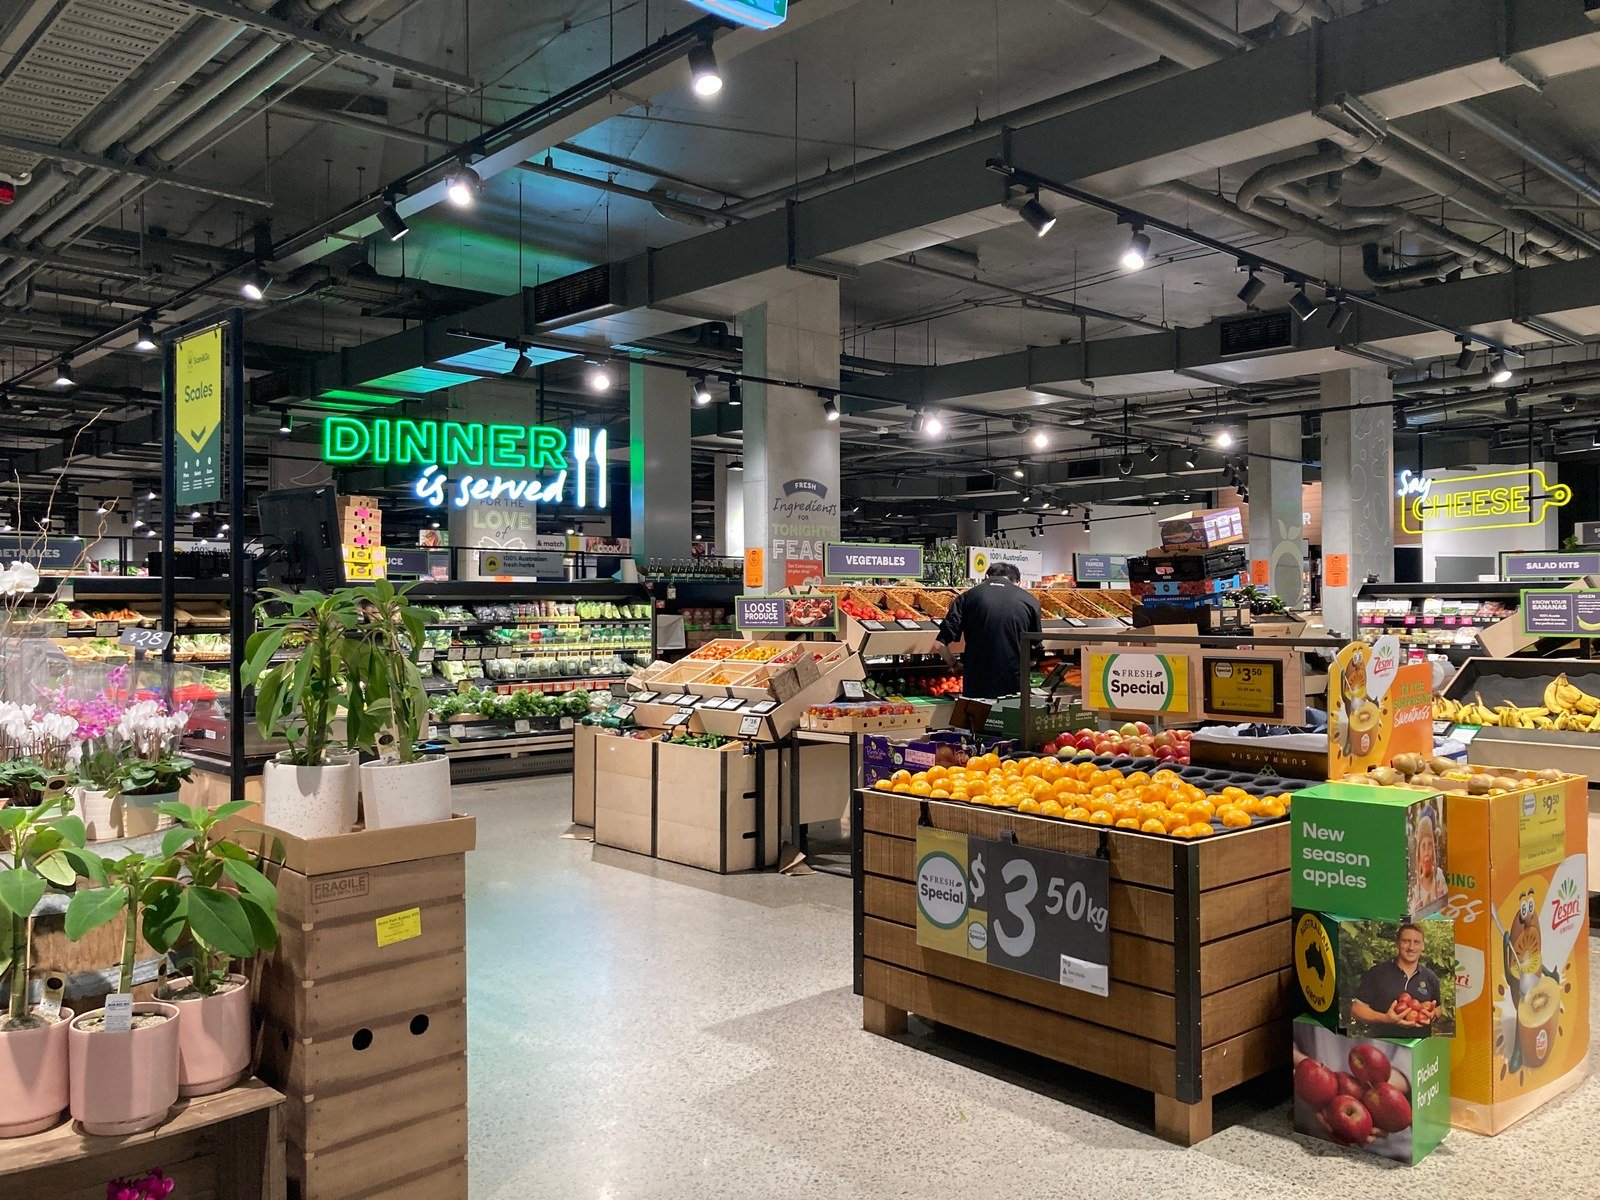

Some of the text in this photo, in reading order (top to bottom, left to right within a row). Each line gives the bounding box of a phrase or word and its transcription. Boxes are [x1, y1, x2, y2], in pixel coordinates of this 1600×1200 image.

[184, 381, 213, 404] Scales
[324, 416, 569, 469] DINNER
[415, 464, 568, 507] is served
[794, 481, 817, 491] FRESH
[1397, 469, 1432, 502] Say
[504, 498, 525, 508] THE
[772, 497, 837, 518] Ingredients
[1411, 485, 1530, 521] CHEESE
[472, 509, 533, 530] LOVE
[496, 526, 511, 540] of
[771, 522, 838, 538] TONIGHT'S
[518, 555, 548, 563] Australian
[772, 539, 824, 561] FEAS
[989, 551, 1029, 562] 100% Australian
[519, 562, 535, 570] herbs
[845, 555, 905, 566] VEGETABLES
[1526, 561, 1580, 570] SALAD KITS
[744, 603, 778, 613] LOOSE
[744, 612, 778, 621] PRODUCE
[129, 631, 164, 646] $28
[1121, 669, 1153, 678] FRESH
[1373, 656, 1395, 675] Zespri
[1110, 679, 1165, 697] Special
[1400, 681, 1425, 695] TRY THE
[1394, 693, 1430, 709] SURPRISING
[1231, 752, 1307, 766] SUNRAYSIA
[1302, 821, 1345, 842] New
[1302, 847, 1370, 867] season
[314, 876, 366, 895] FRAGILE
[929, 875, 955, 887] FRESH
[1302, 869, 1367, 888] apples
[920, 883, 965, 905] Special
[1551, 894, 1581, 931] Zespri
[969, 932, 986, 942] Special
[1300, 918, 1330, 952] AUSTRALIAN
[1305, 985, 1326, 1006] GROWN
[1417, 1055, 1439, 1088] Picked
[1417, 1081, 1440, 1110] for you
